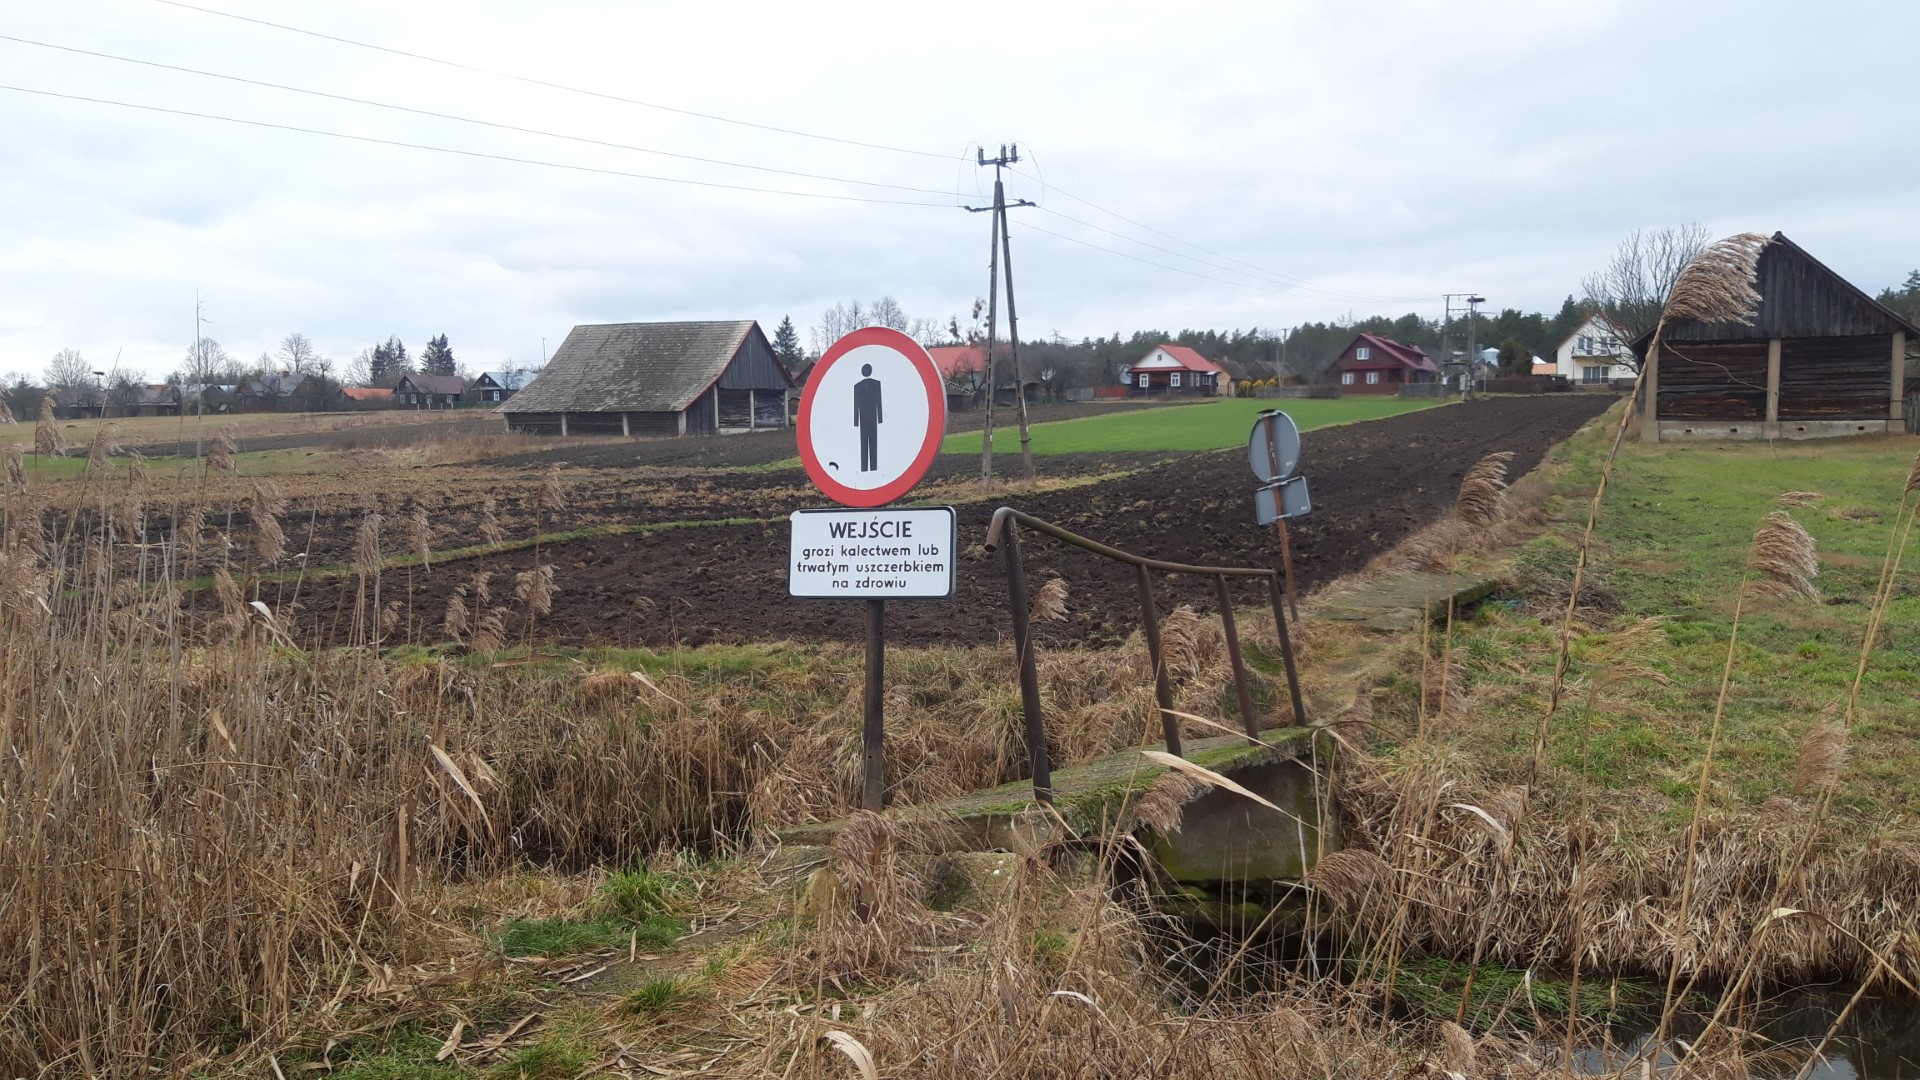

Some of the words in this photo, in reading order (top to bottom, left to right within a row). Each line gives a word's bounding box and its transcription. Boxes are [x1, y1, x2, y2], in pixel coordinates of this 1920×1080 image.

[829, 516, 912, 539] WEJŚCIE
[802, 545, 834, 560] grozi
[841, 545, 911, 557] kalectwem
[918, 544, 939, 556] lub
[797, 560, 849, 576] trwałym
[856, 560, 944, 573] uszczerbkiem
[832, 579, 848, 588] na
[855, 576, 907, 588] zdrowiu
